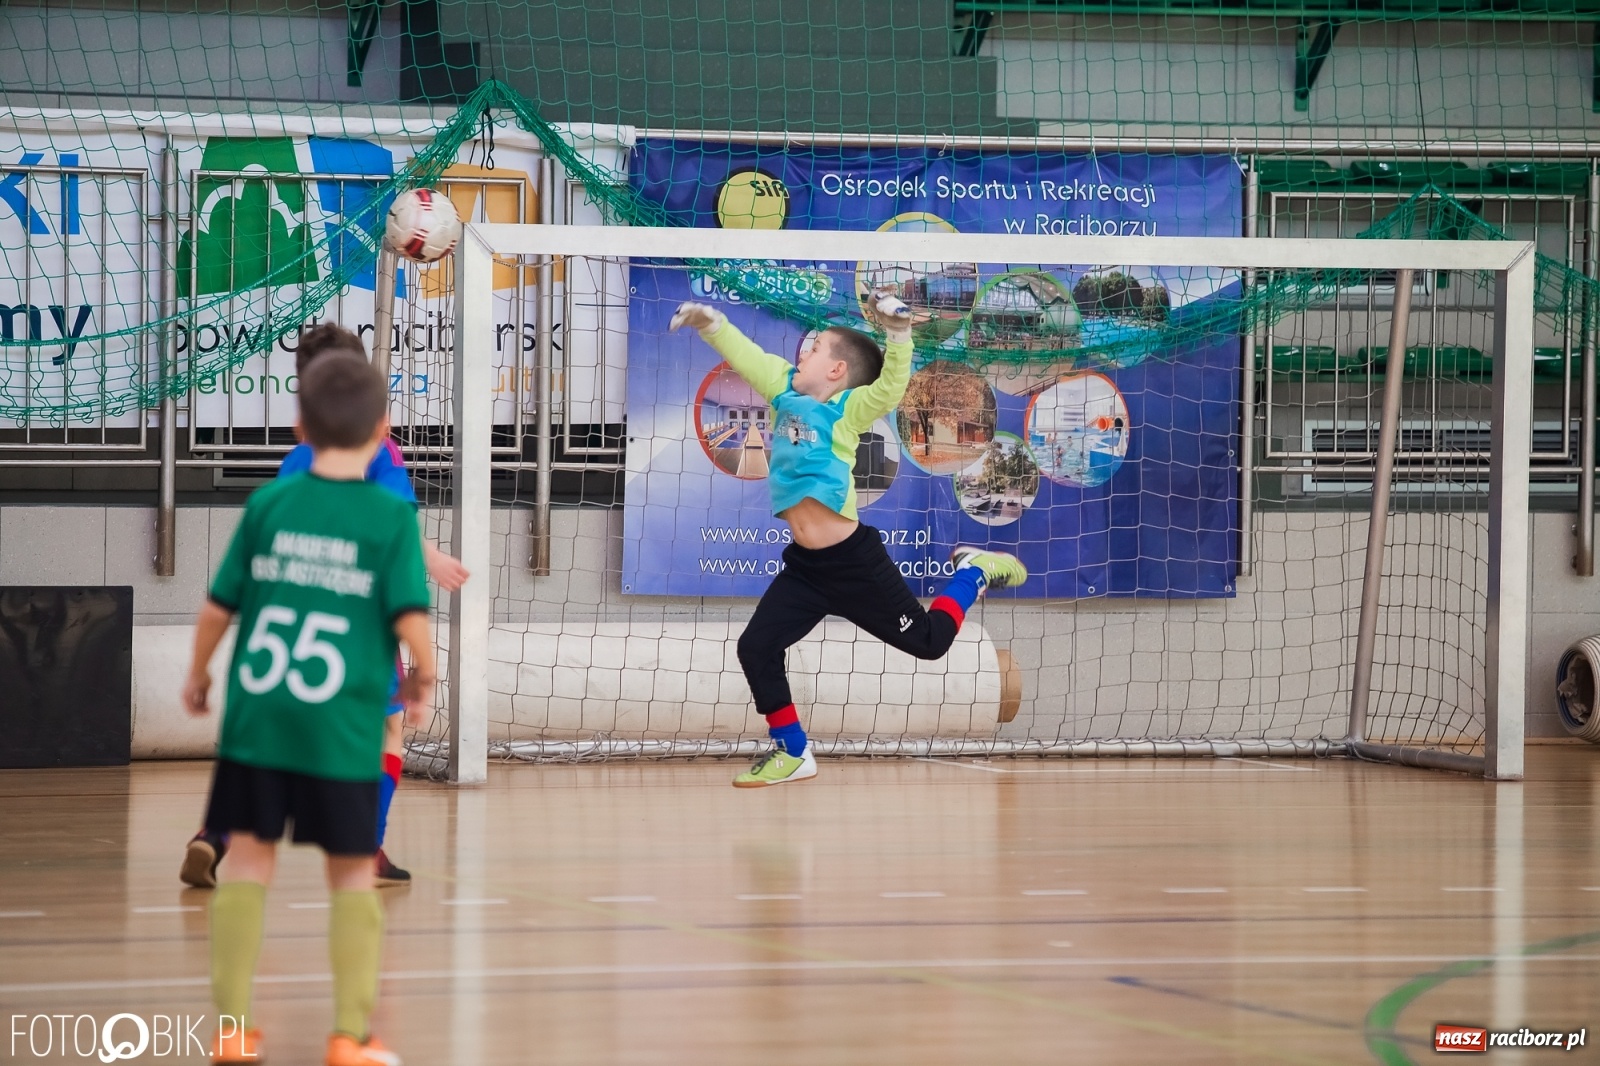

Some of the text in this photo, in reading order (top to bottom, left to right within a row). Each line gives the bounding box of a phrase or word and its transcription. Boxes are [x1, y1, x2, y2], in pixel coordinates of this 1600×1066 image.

[820, 173, 1156, 208] Ośrodek Sportu i Rekreacji
[1003, 213, 1157, 236] w Raciborzu
[238, 604, 350, 704] 55
